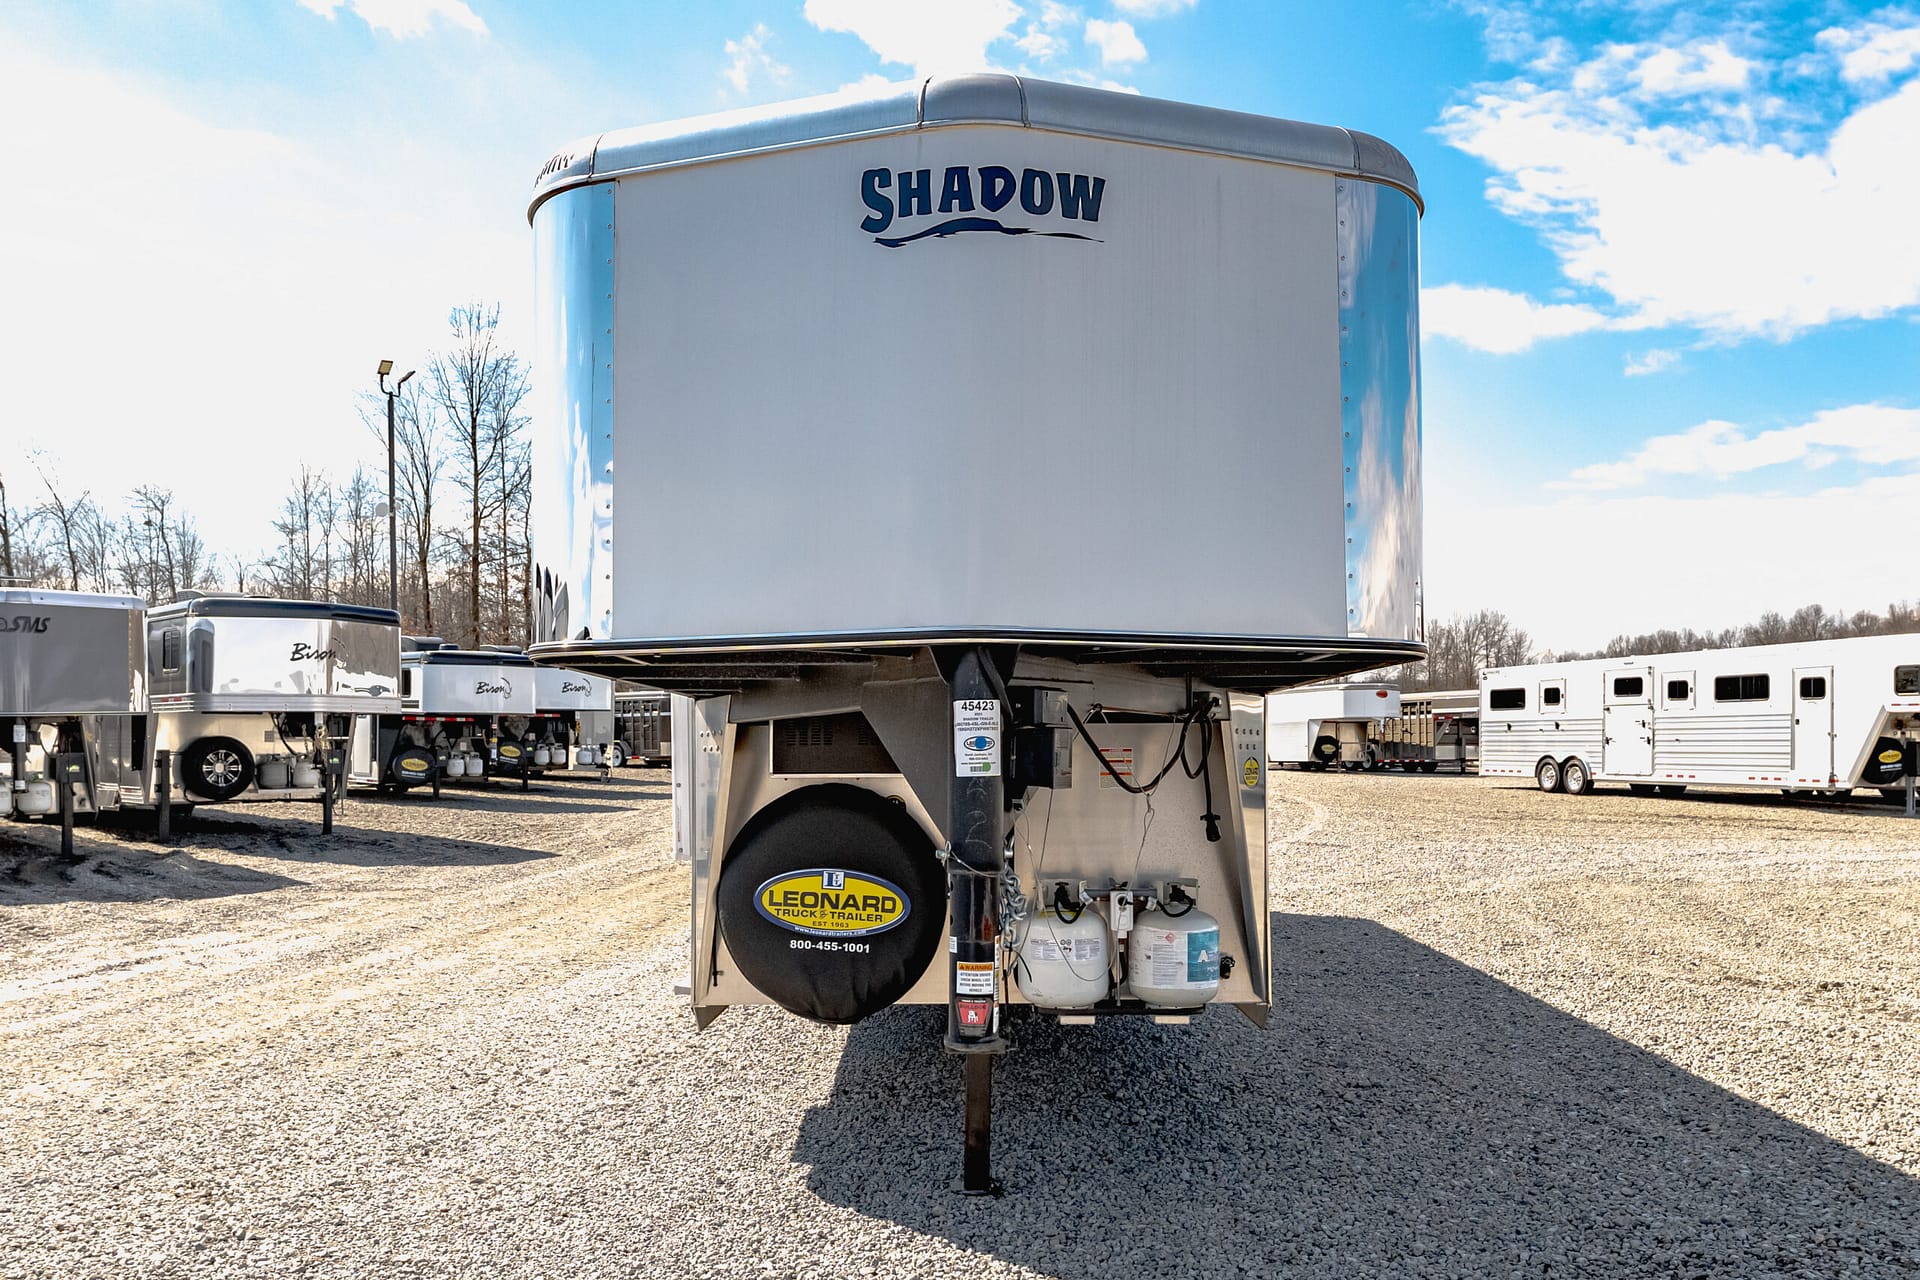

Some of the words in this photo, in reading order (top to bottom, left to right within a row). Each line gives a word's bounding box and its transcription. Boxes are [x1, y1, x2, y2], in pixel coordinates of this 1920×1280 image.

[860, 165, 1107, 234] SHADOW
[10, 616, 51, 634] SMS
[290, 642, 337, 662] Bison
[476, 680, 505, 695] Bison
[561, 681, 586, 694] Bison
[961, 700, 995, 712] 45423
[768, 889, 897, 914] LEONARD
[774, 907, 817, 919] TRUCK
[829, 911, 884, 923] TRAILER
[830, 921, 850, 929] 1963
[789, 939, 870, 954] 800-455-1001
[965, 963, 993, 971] WARNING
